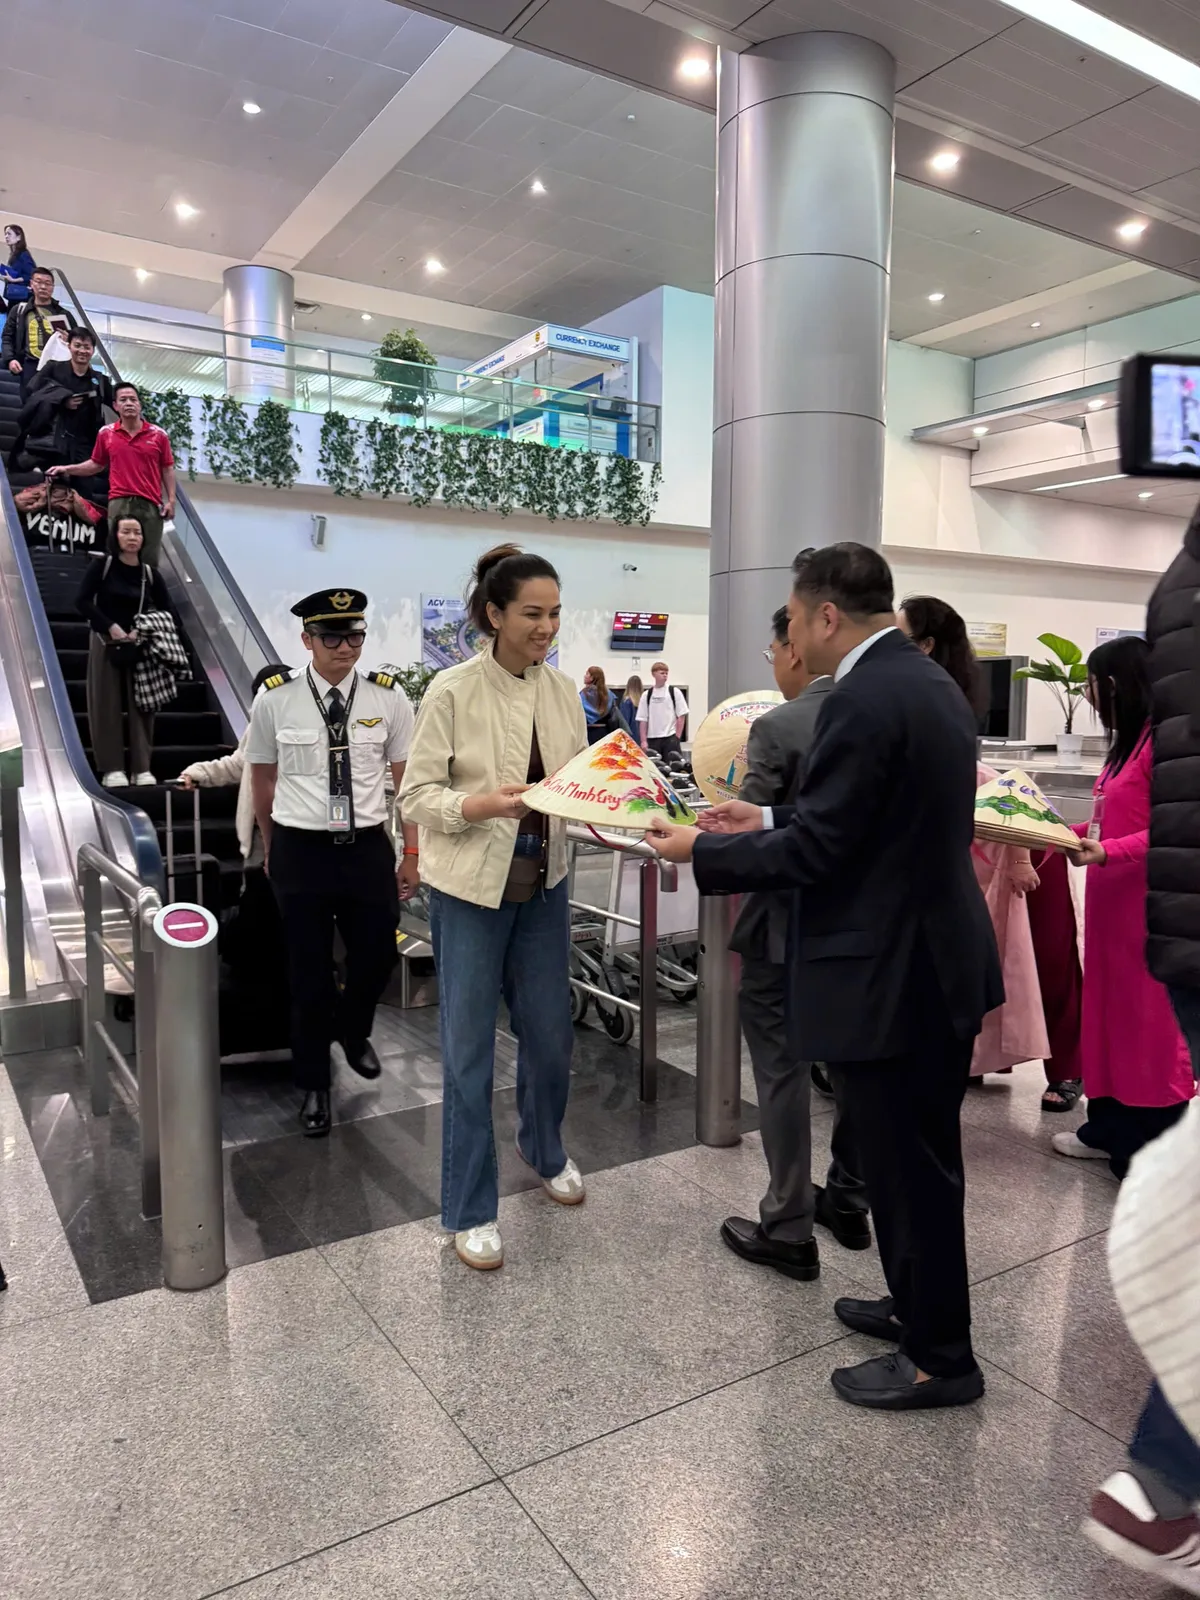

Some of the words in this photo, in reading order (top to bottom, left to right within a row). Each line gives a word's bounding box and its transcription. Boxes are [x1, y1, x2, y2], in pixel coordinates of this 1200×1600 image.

[555, 333, 587, 346] CURRENCY
[588, 339, 621, 353] EXCHANGE
[26, 512, 96, 545] VENUM
[561, 781, 596, 801] Minh
